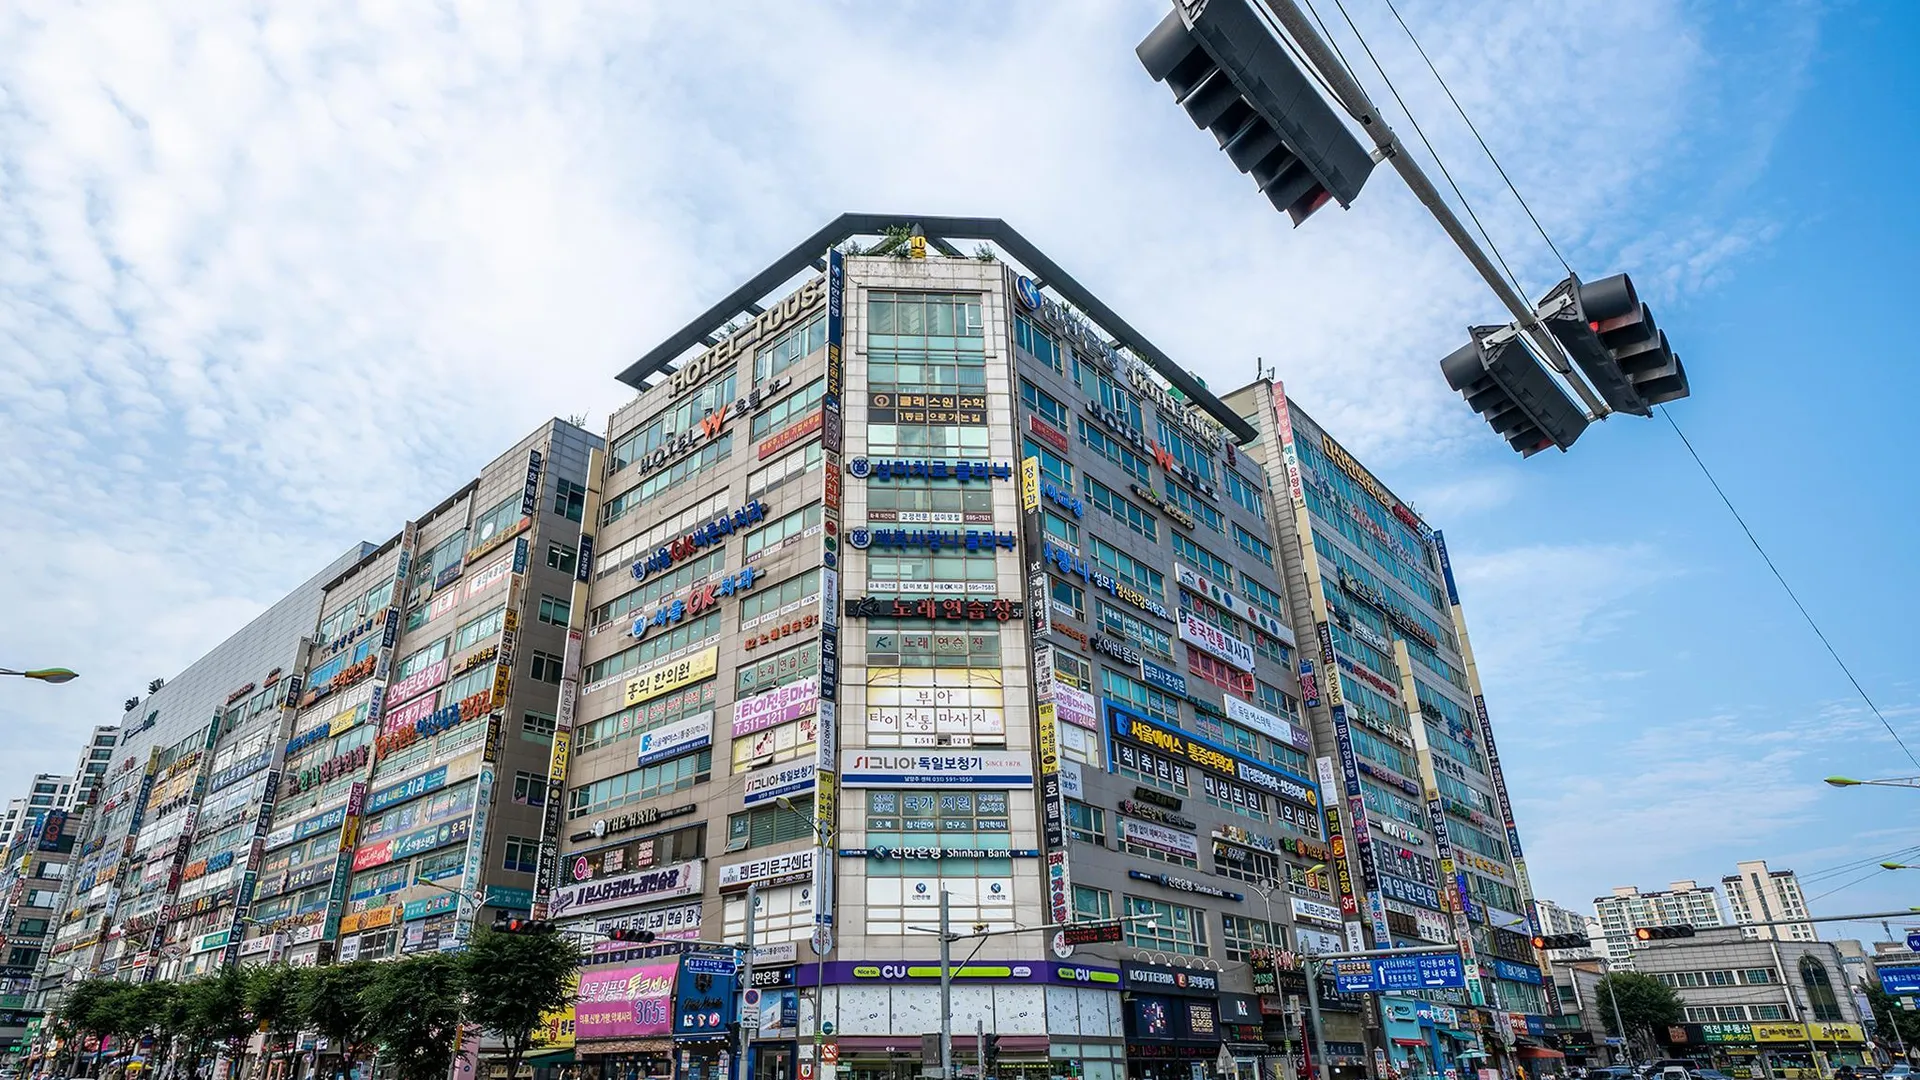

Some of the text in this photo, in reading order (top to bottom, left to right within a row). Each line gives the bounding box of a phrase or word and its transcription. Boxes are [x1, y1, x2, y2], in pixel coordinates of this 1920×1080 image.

[960, 397, 985, 409] 수학
[701, 405, 728, 440] W
[1151, 439, 1174, 472] W
[1025, 467, 1036, 505] 정신과
[892, 599, 1010, 621] 노래연습장
[628, 661, 691, 701] 홍익 한의원
[1328, 673, 1341, 703] SEYANG
[916, 691, 953, 704] 부아
[552, 740, 567, 778] 정신과
[918, 756, 983, 770] 독일보청기
[904, 796, 935, 811] 국가
[941, 796, 971, 811] 지원
[1046, 782, 1059, 819] 호텔
[606, 808, 658, 833] THE HAIR
[890, 846, 1012, 859] 신한은행 Shinhan Bank
[1381, 875, 1439, 908] 제일한의원
[882, 964, 906, 979] CU
[1075, 967, 1090, 981] CU
[1129, 969, 1176, 986] LOTTERIA
[1191, 1018, 1213, 1029] BURGER
[1703, 1024, 1721, 1034] 역전
[1723, 1024, 1751, 1034] 부동산
